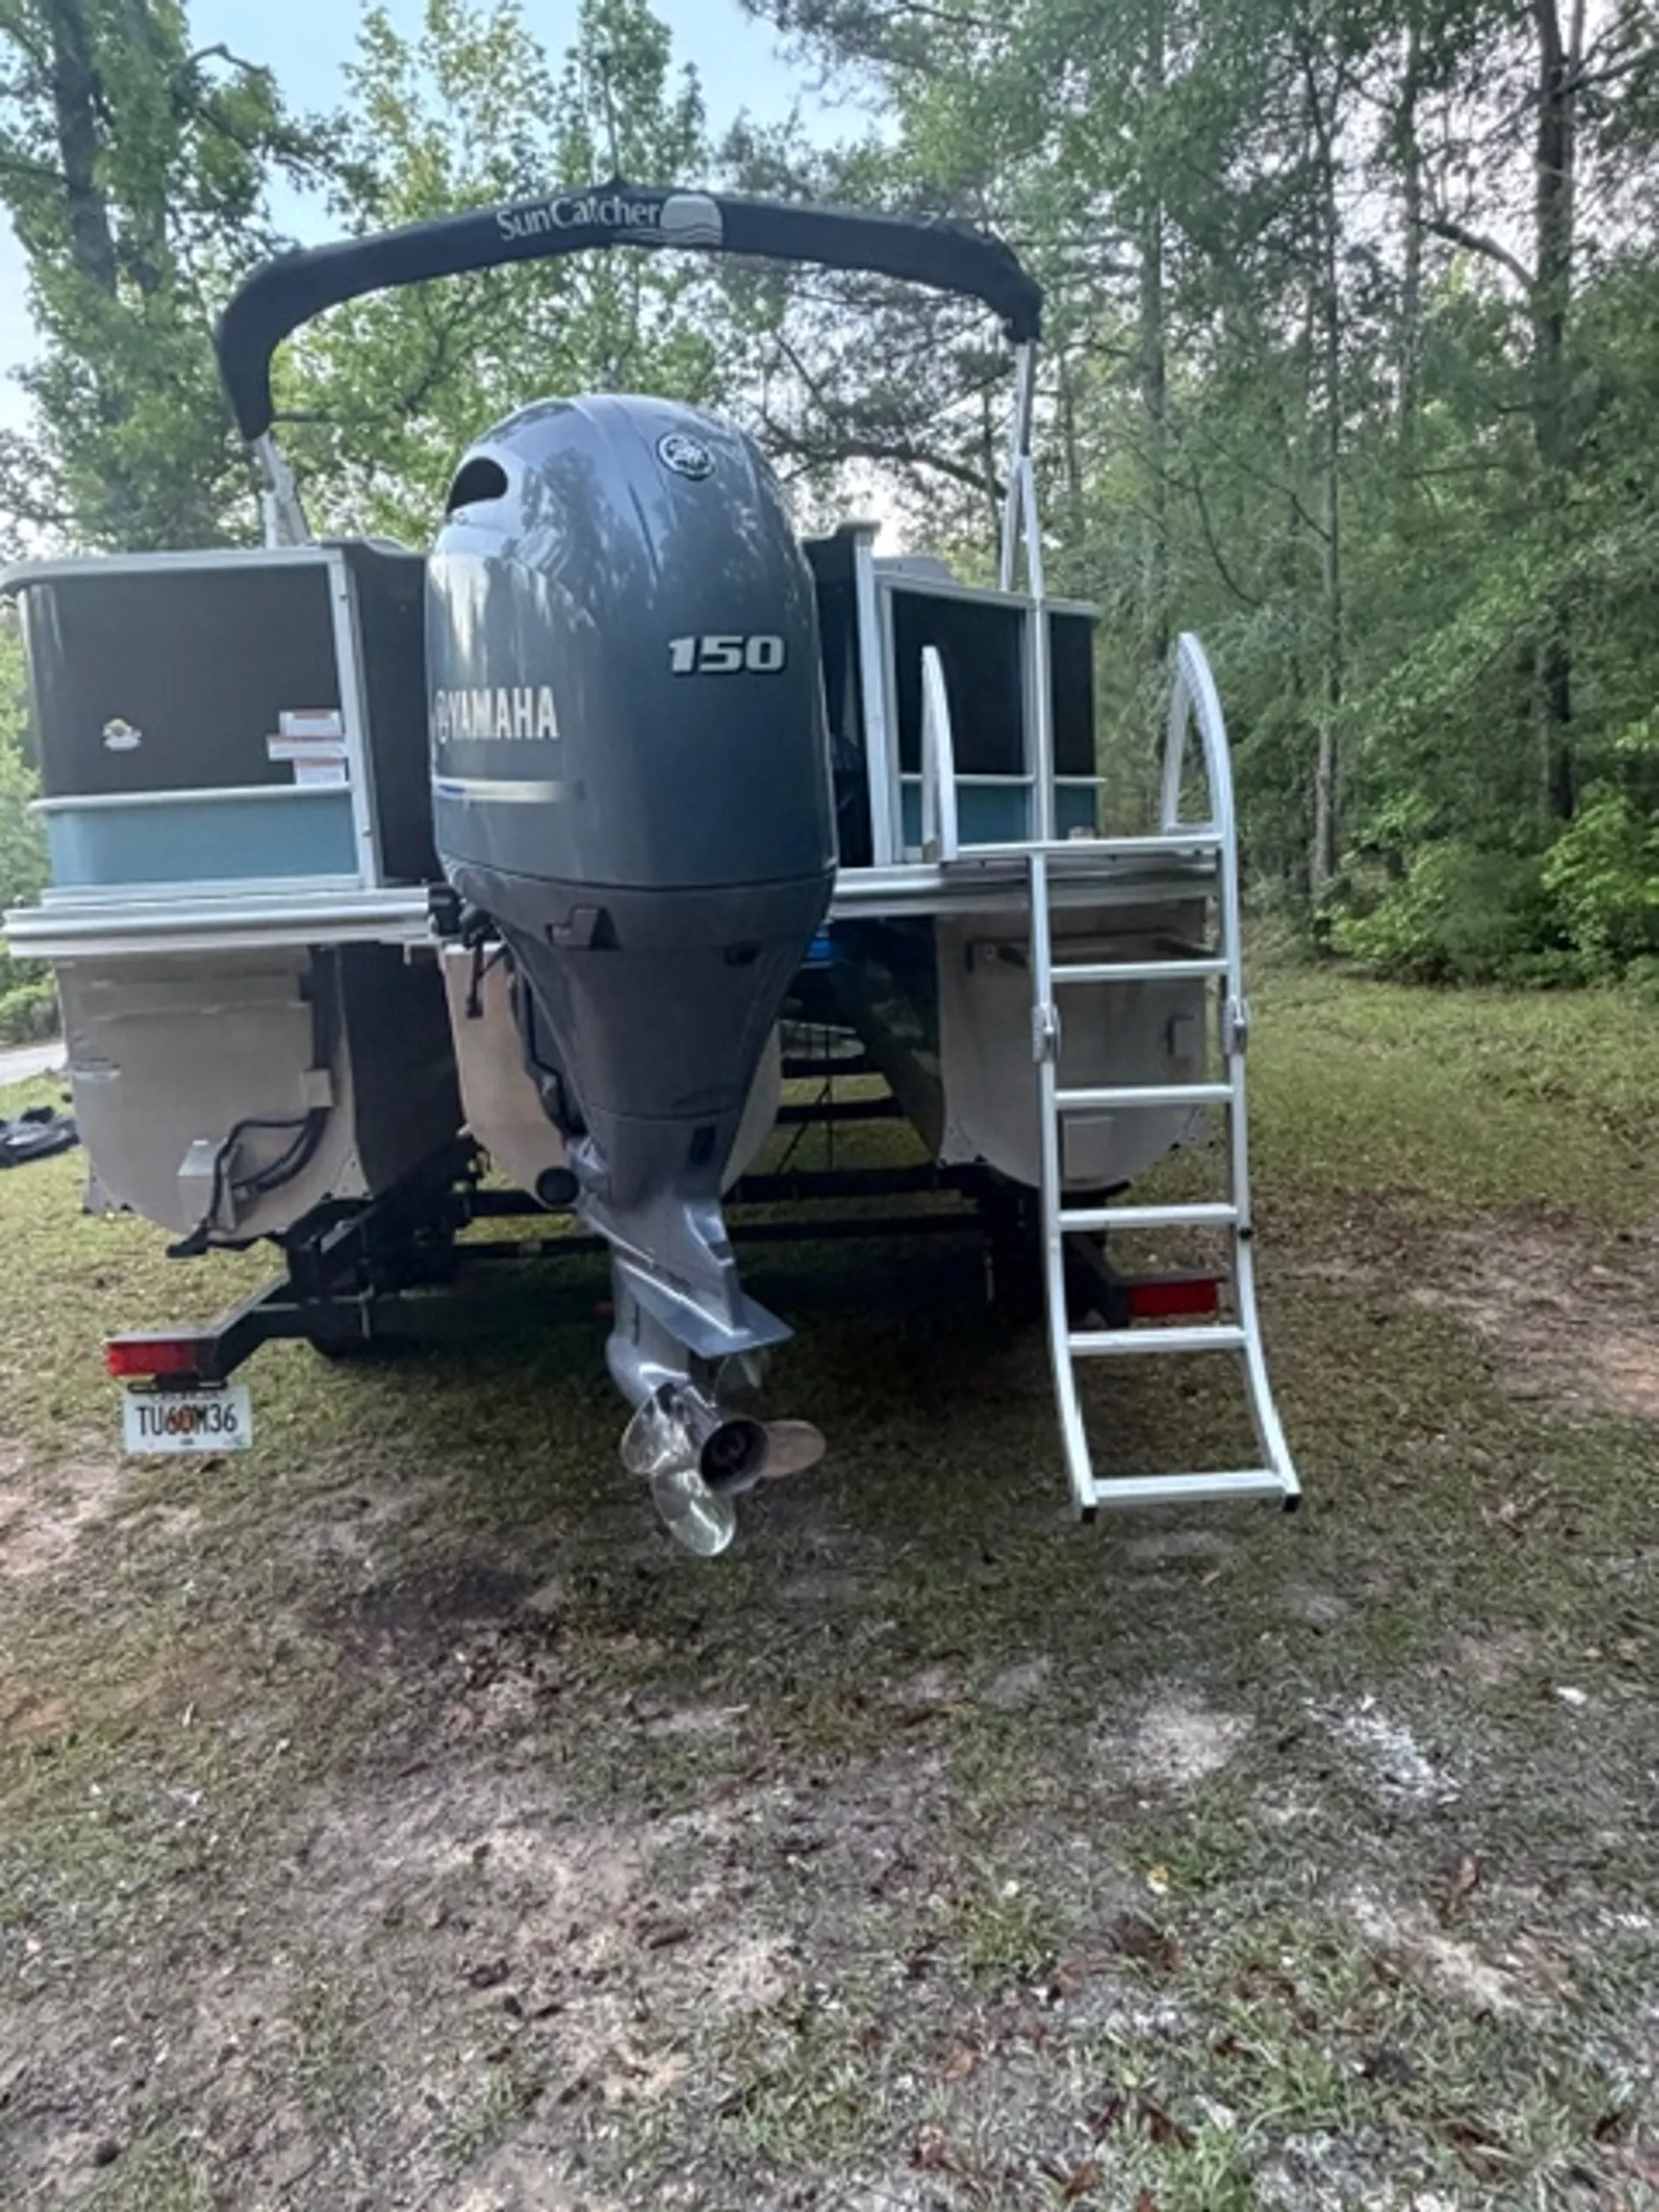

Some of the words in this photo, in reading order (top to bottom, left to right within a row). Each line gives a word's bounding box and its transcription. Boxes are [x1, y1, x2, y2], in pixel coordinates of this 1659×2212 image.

[496, 196, 659, 241] SunCatcher
[669, 635, 786, 672] 150
[448, 685, 560, 740] YAMAHA
